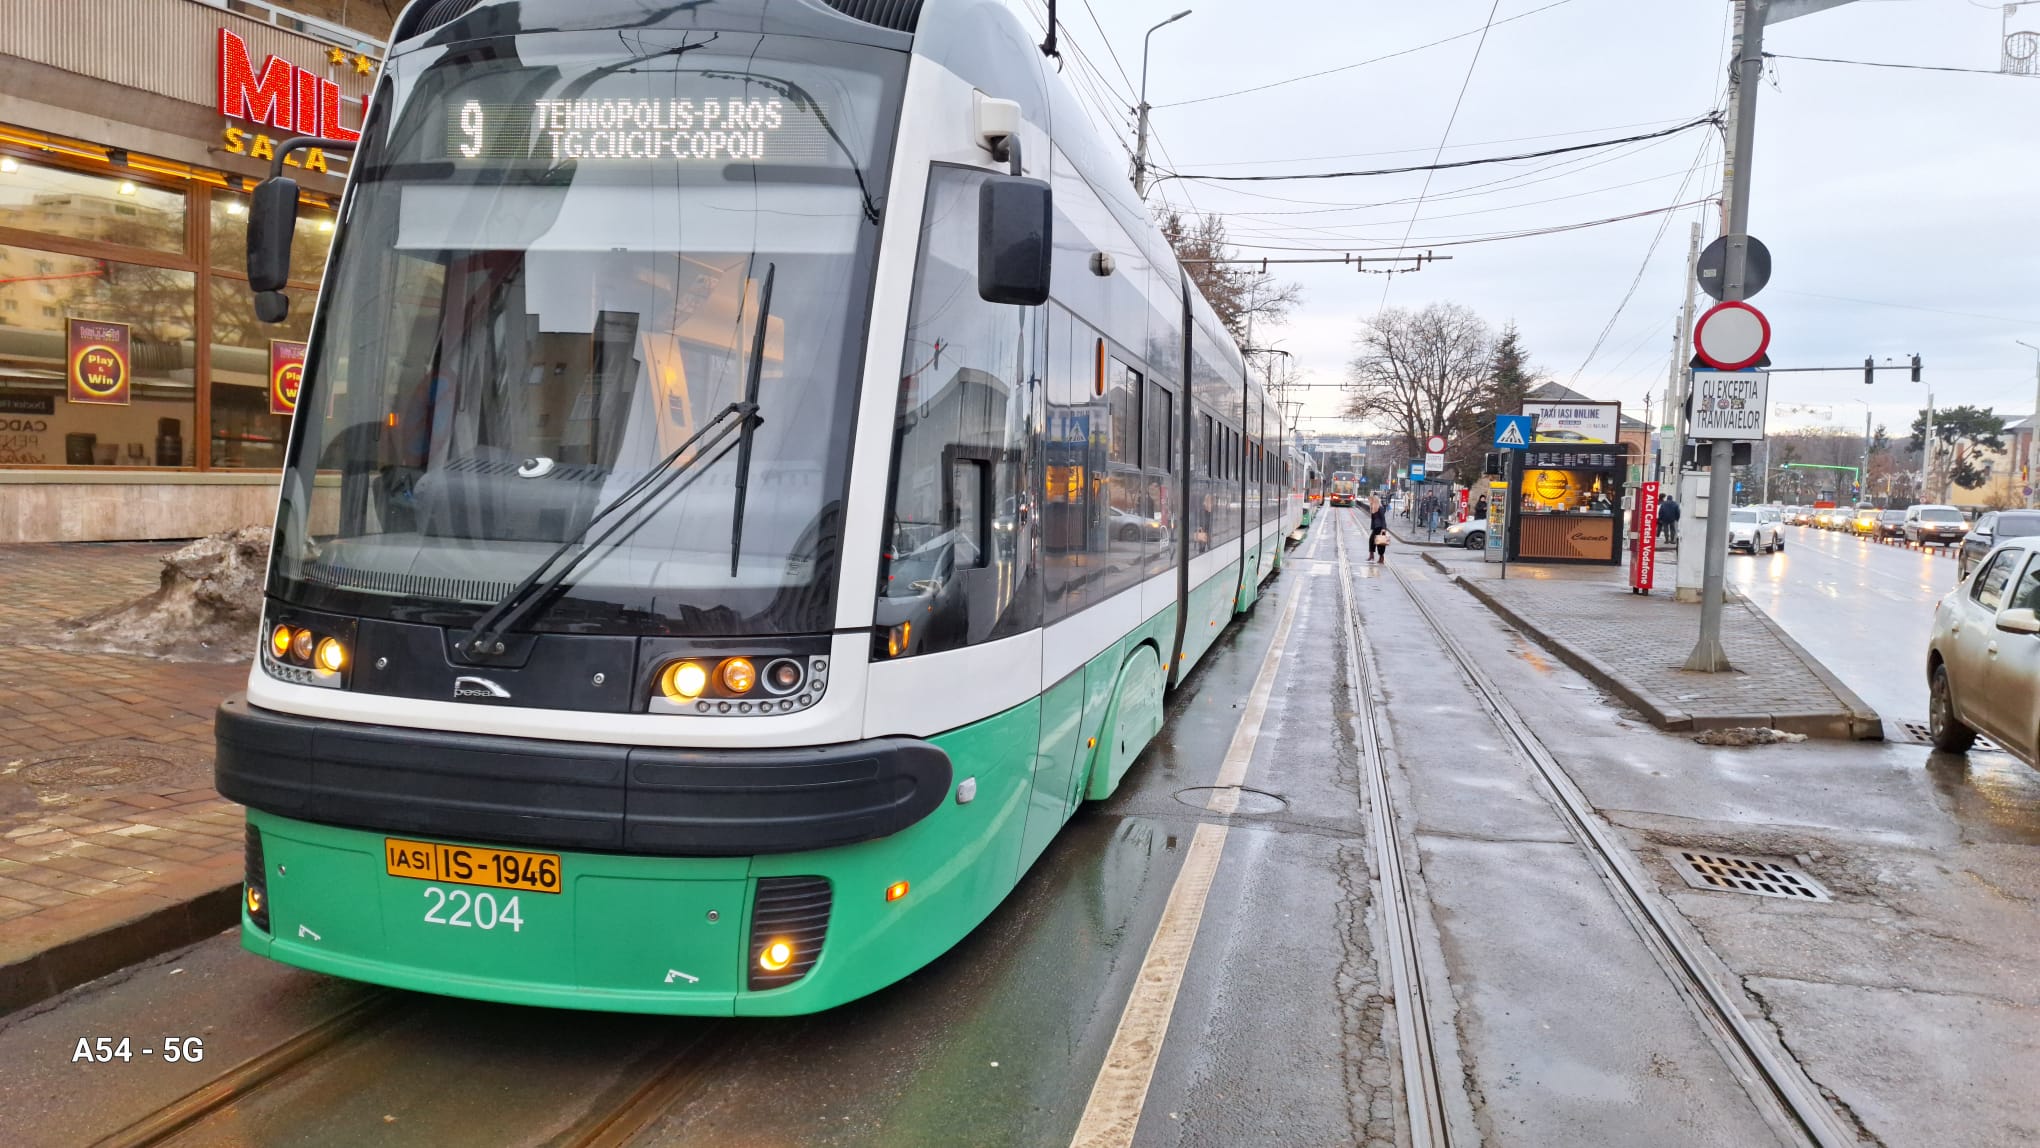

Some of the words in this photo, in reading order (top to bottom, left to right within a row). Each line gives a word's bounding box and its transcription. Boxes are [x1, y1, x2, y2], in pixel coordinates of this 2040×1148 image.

[218, 28, 372, 142] MIL
[536, 98, 783, 129] TEHNOPOLIS-P.ROS
[460, 100, 484, 158] 9
[548, 131, 764, 159] TG.CUCU-COPOU
[88, 354, 114, 367] Play
[87, 373, 114, 385] Win
[286, 371, 301, 381] Pla
[1702, 380, 1715, 398] CU
[1717, 380, 1758, 399] EXCEPTIA
[1540, 408, 1557, 419] TAXI
[1574, 408, 1601, 419] ONLINE
[1697, 409, 1760, 429] TRAMVAIELOR
[1645, 494, 1655, 512] AICI
[1643, 514, 1654, 544] Cartela
[1640, 546, 1651, 584] Vodafone
[390, 848, 430, 871] IASI
[423, 887, 524, 932] 2204
